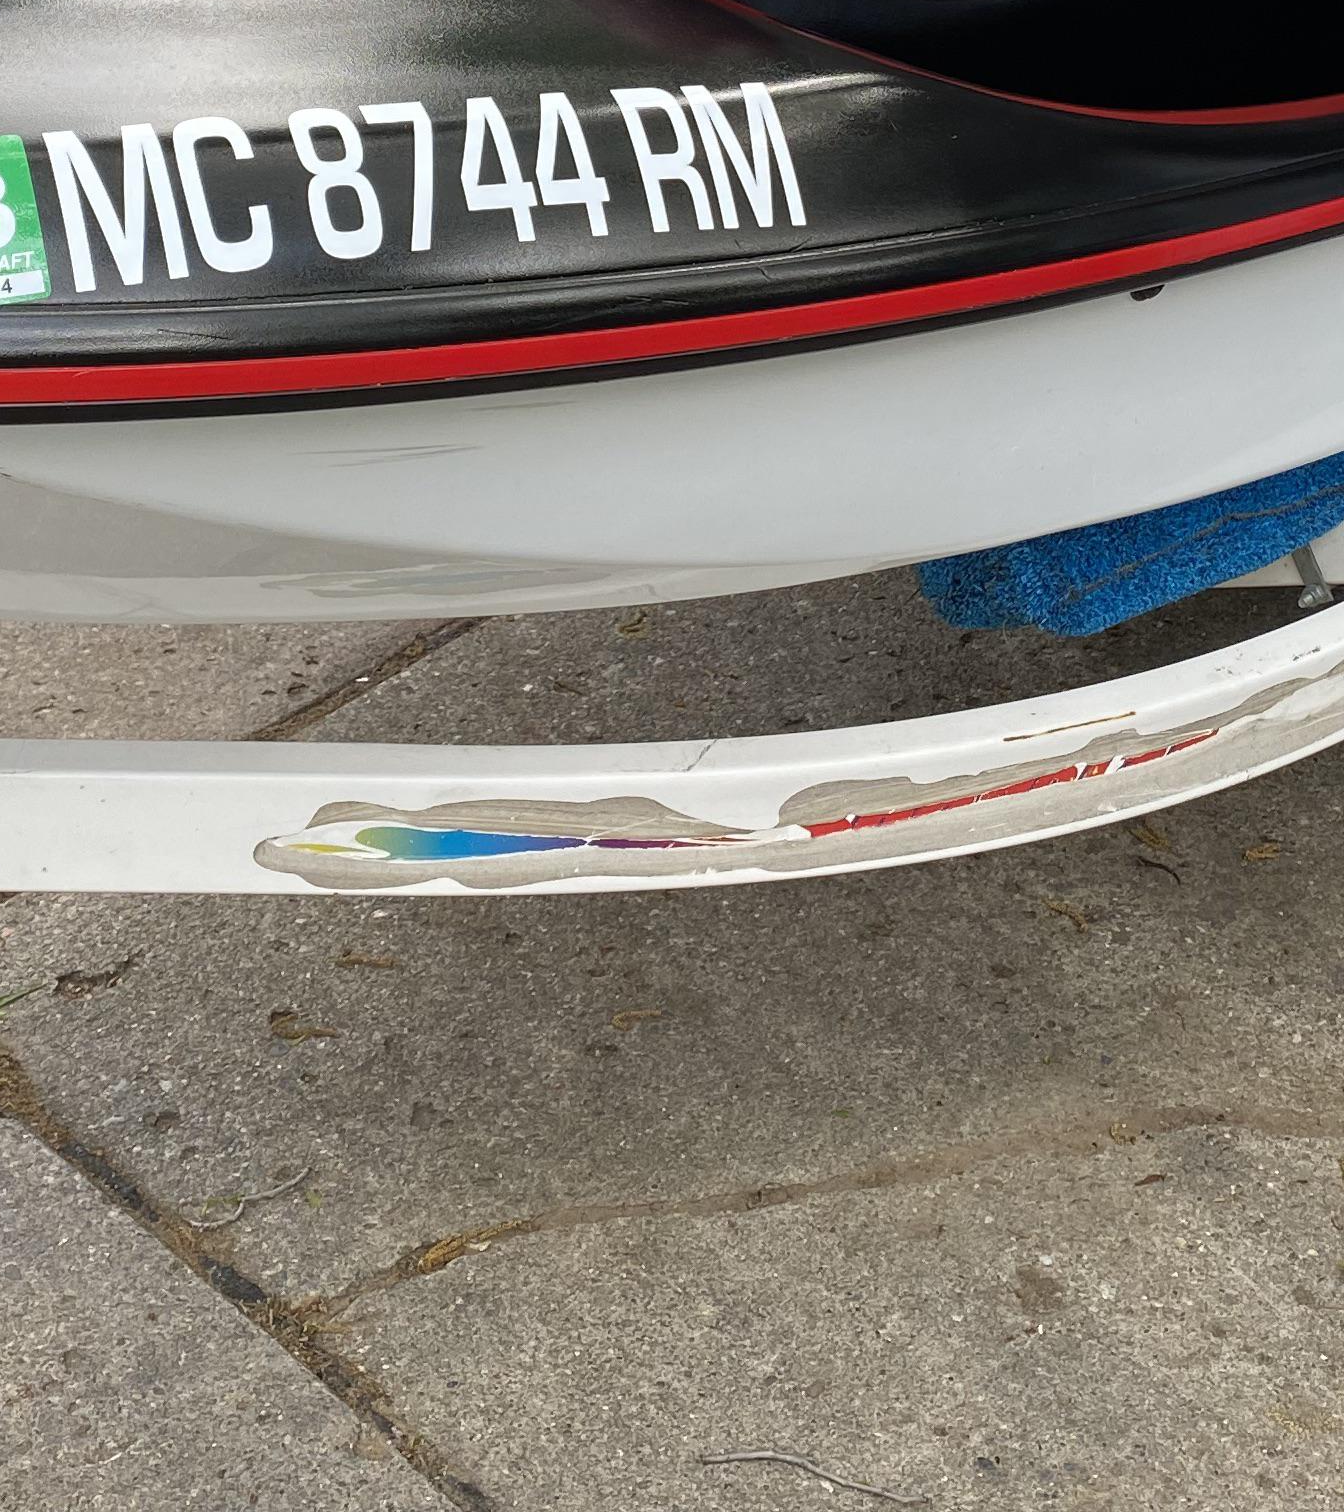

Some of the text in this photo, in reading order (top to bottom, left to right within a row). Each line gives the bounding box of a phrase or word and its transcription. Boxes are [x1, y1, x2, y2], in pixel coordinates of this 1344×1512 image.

[42, 81, 808, 293] MC 8744 RM
